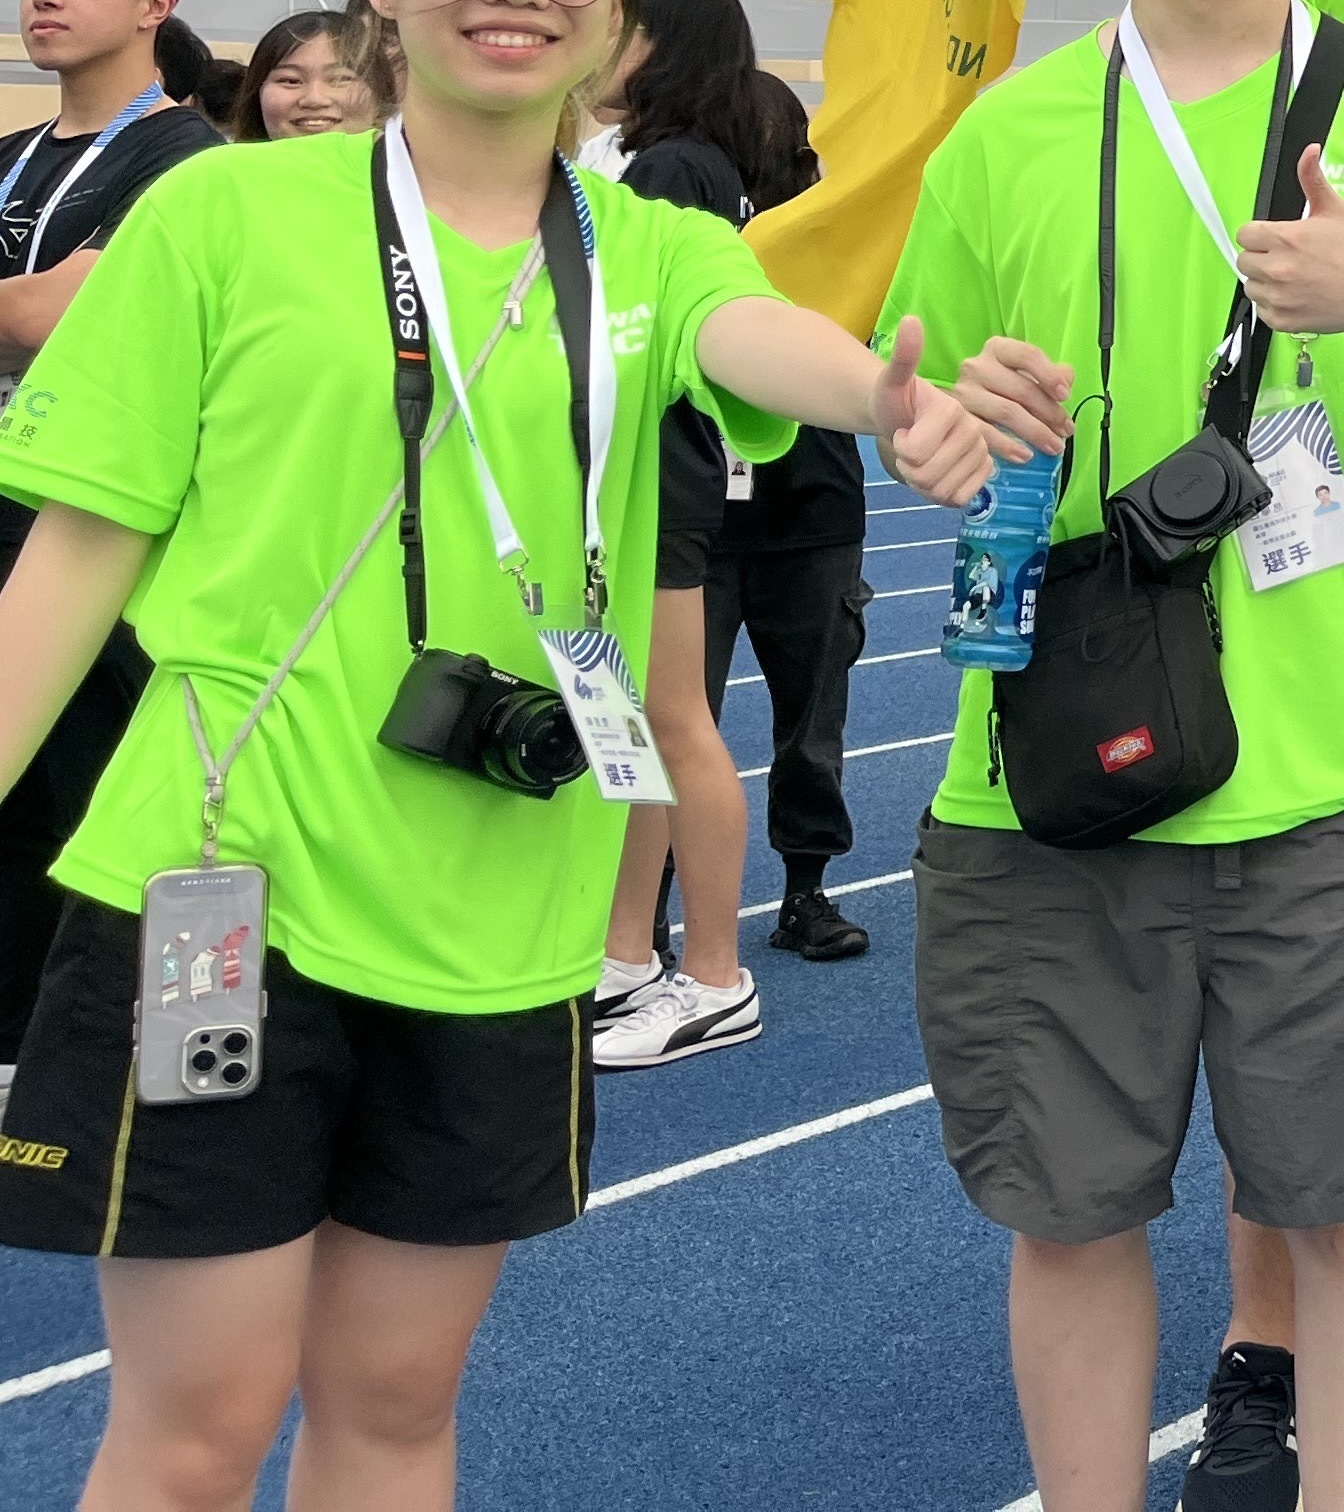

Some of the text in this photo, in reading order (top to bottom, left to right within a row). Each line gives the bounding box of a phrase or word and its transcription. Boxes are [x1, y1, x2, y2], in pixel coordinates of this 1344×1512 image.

[389, 245, 420, 340] SONY
[1261, 540, 1312, 576] 選手
[490, 670, 519, 686] SONY
[603, 763, 637, 787] 選手
